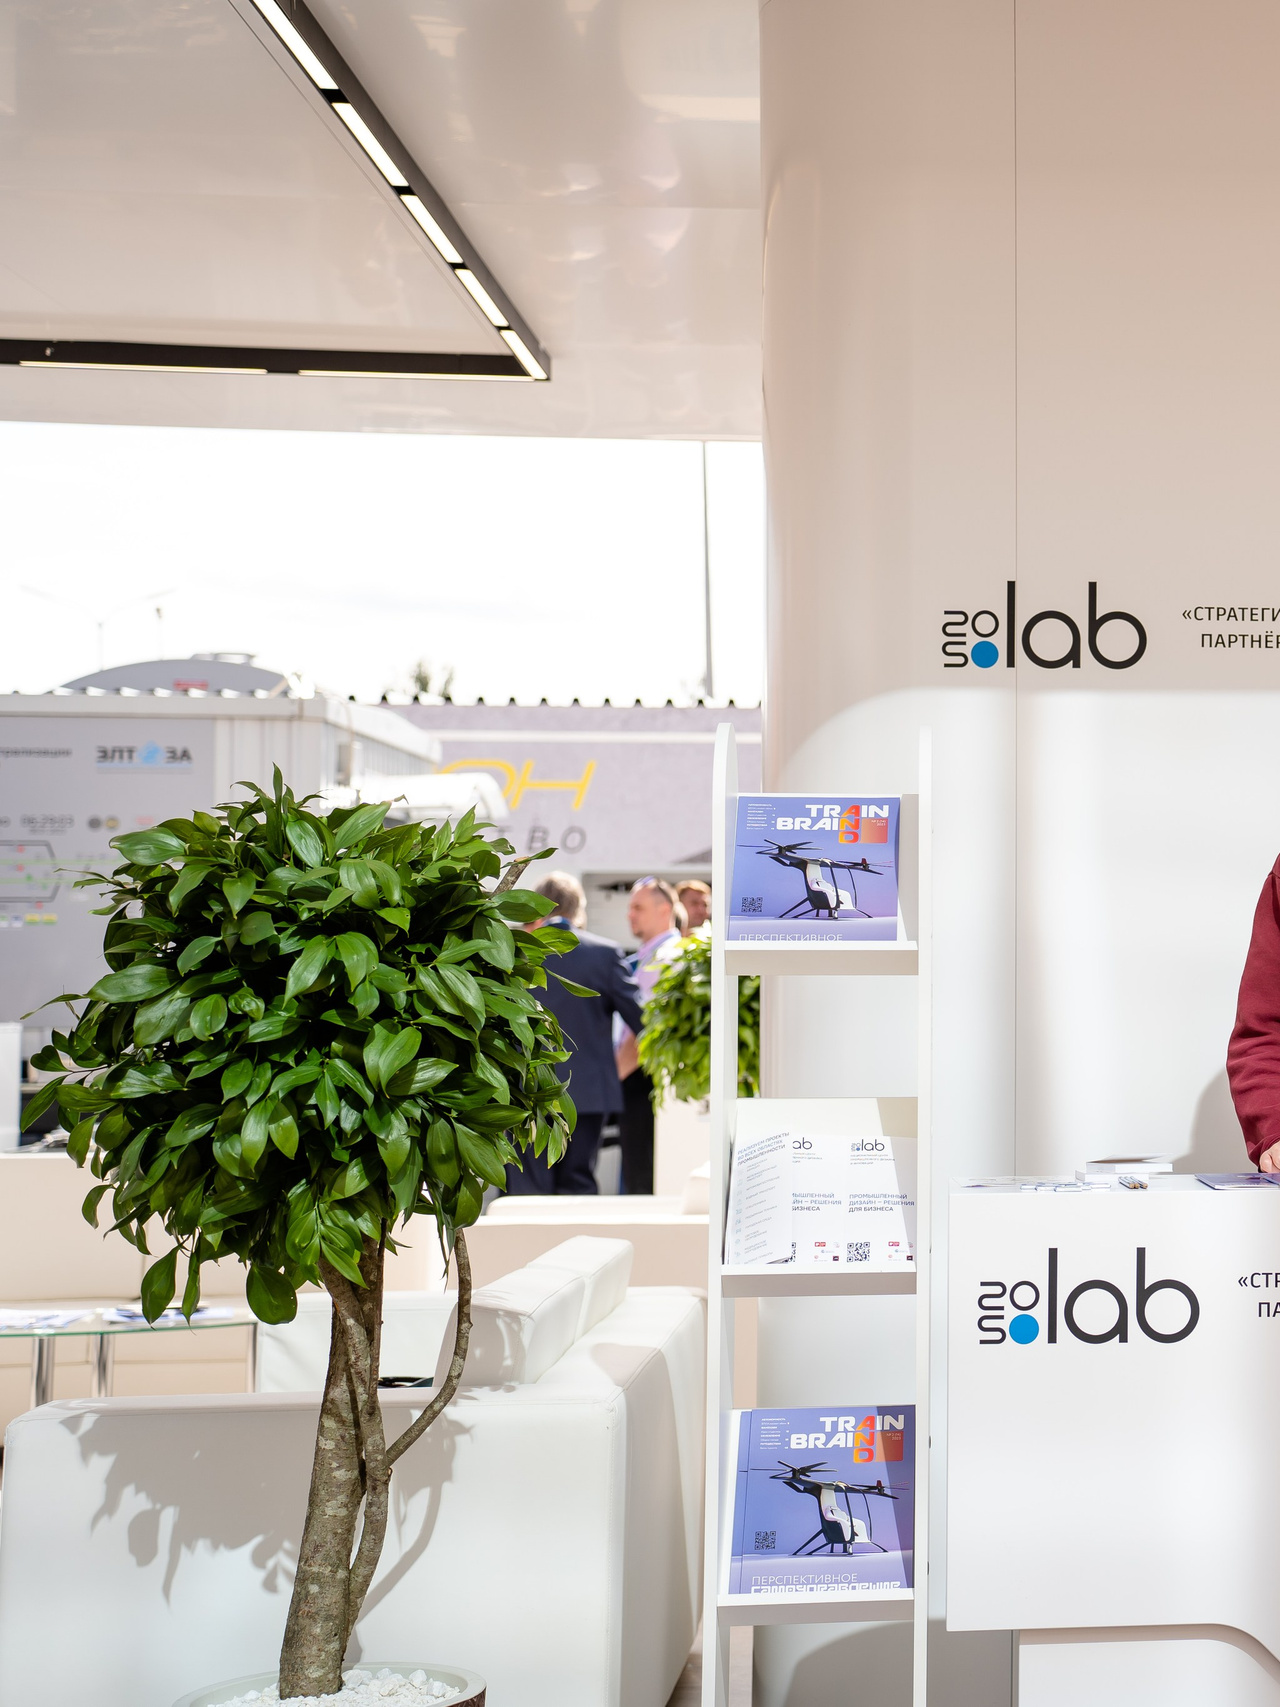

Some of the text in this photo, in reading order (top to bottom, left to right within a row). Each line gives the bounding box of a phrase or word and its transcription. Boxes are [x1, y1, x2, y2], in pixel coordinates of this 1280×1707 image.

[1007, 581, 1147, 669] lab
[805, 804, 889, 818] TRAIN
[776, 817, 860, 831] BRAIN
[861, 1139, 885, 1152] lab
[1047, 1247, 1200, 1344] lab
[819, 1415, 904, 1431] TRAIN
[790, 1431, 874, 1449] BRAIN
[751, 1573, 858, 1585] ПЕРСПЕКТИВНОЕ
